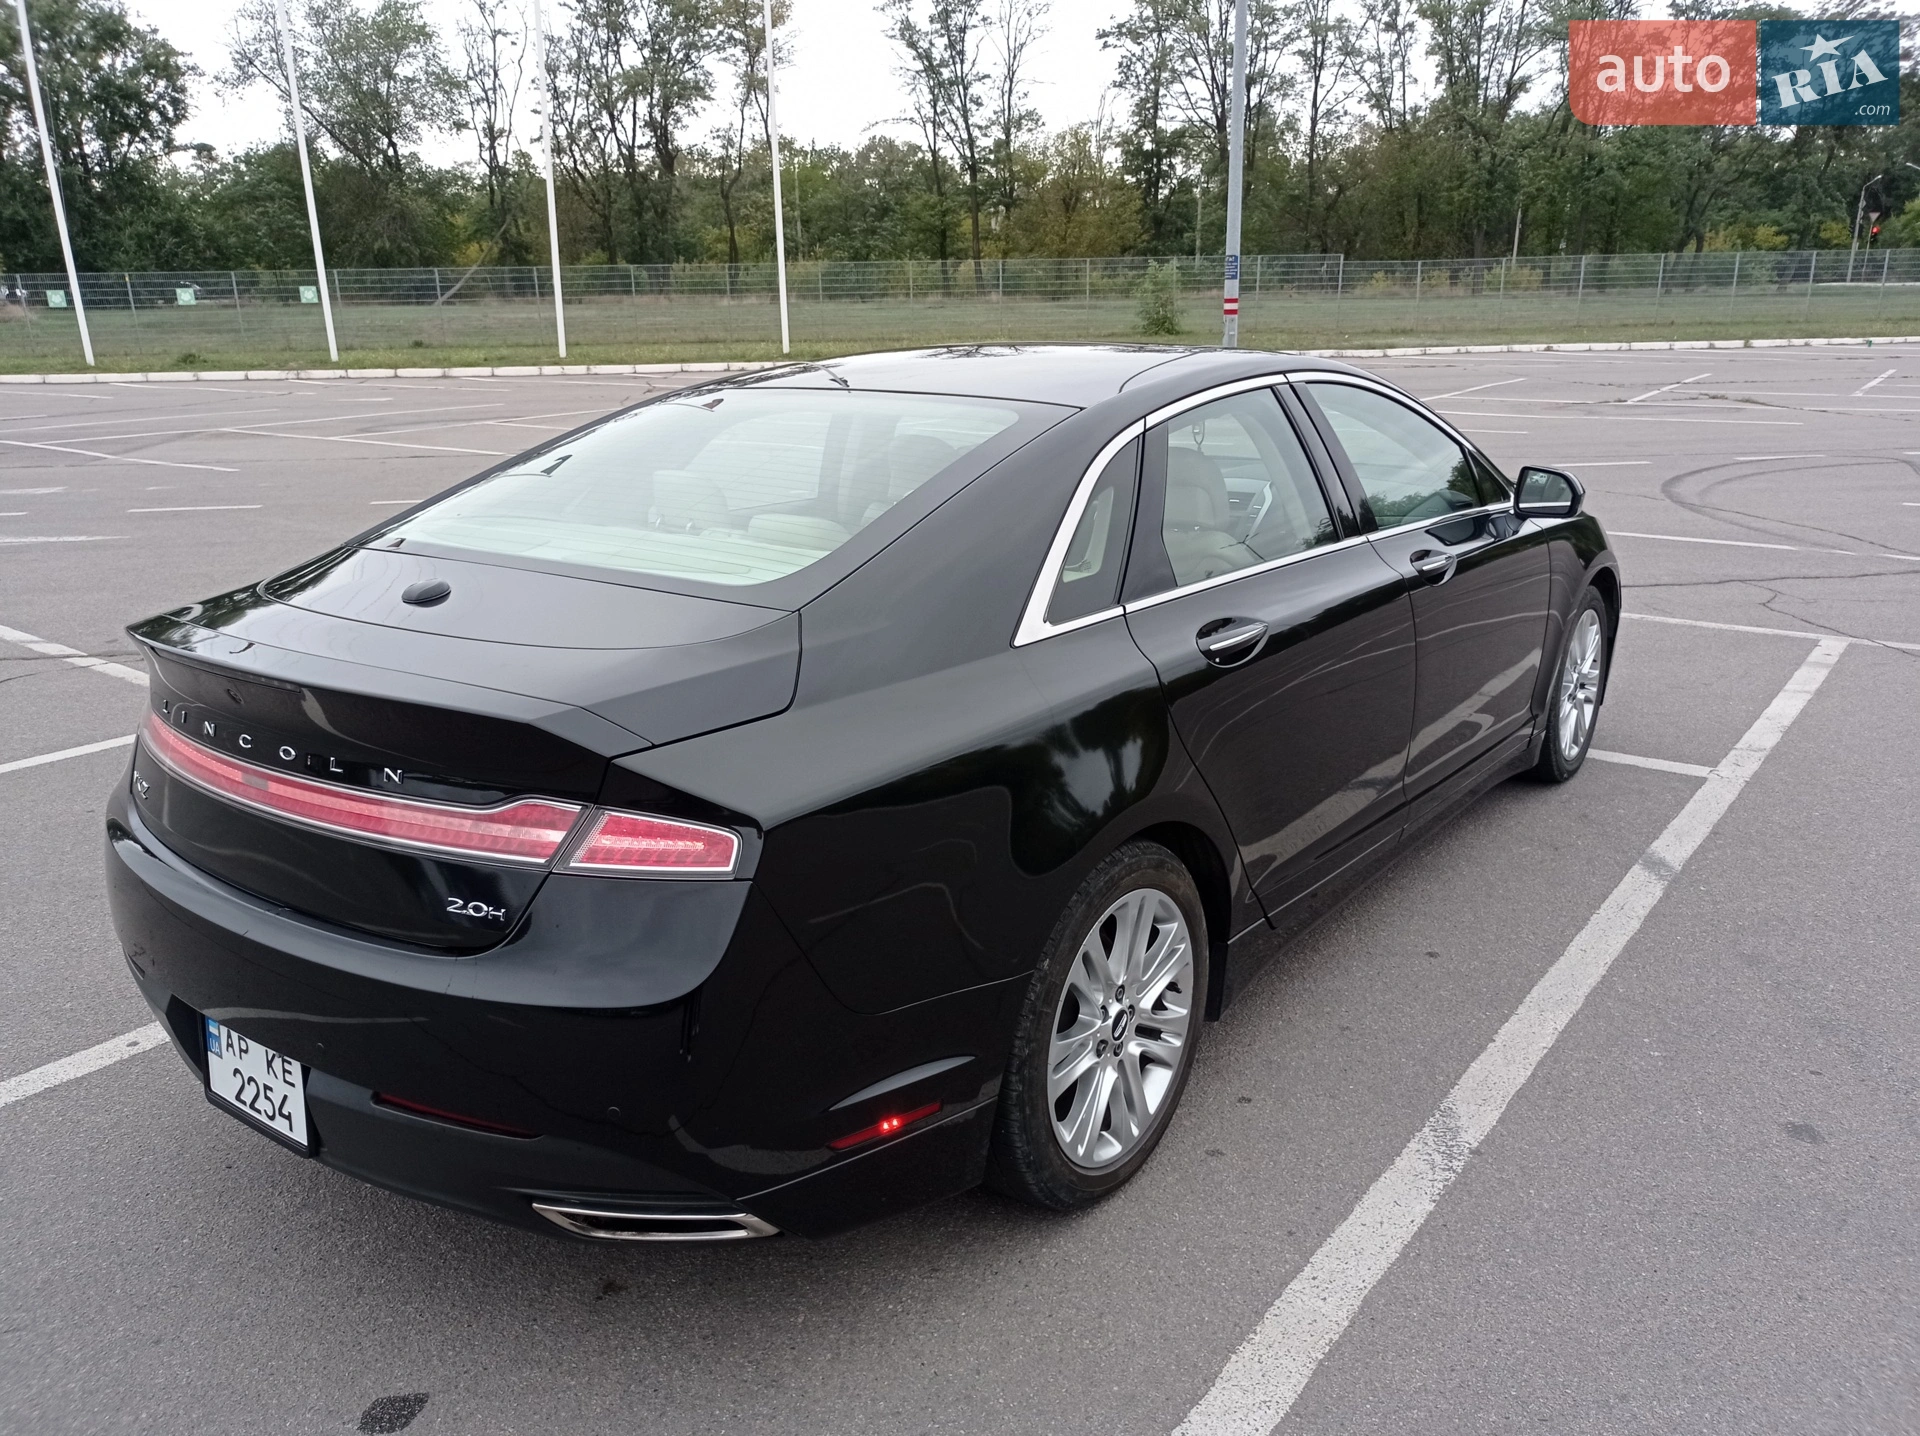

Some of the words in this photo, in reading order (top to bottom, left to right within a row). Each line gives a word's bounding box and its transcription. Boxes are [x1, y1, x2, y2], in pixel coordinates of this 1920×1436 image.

[162, 699, 403, 784] LINCOLN
[209, 1038, 221, 1053] UA
[226, 1028, 249, 1060] AP
[265, 1049, 296, 1088] KE
[232, 1067, 294, 1132] 2254
